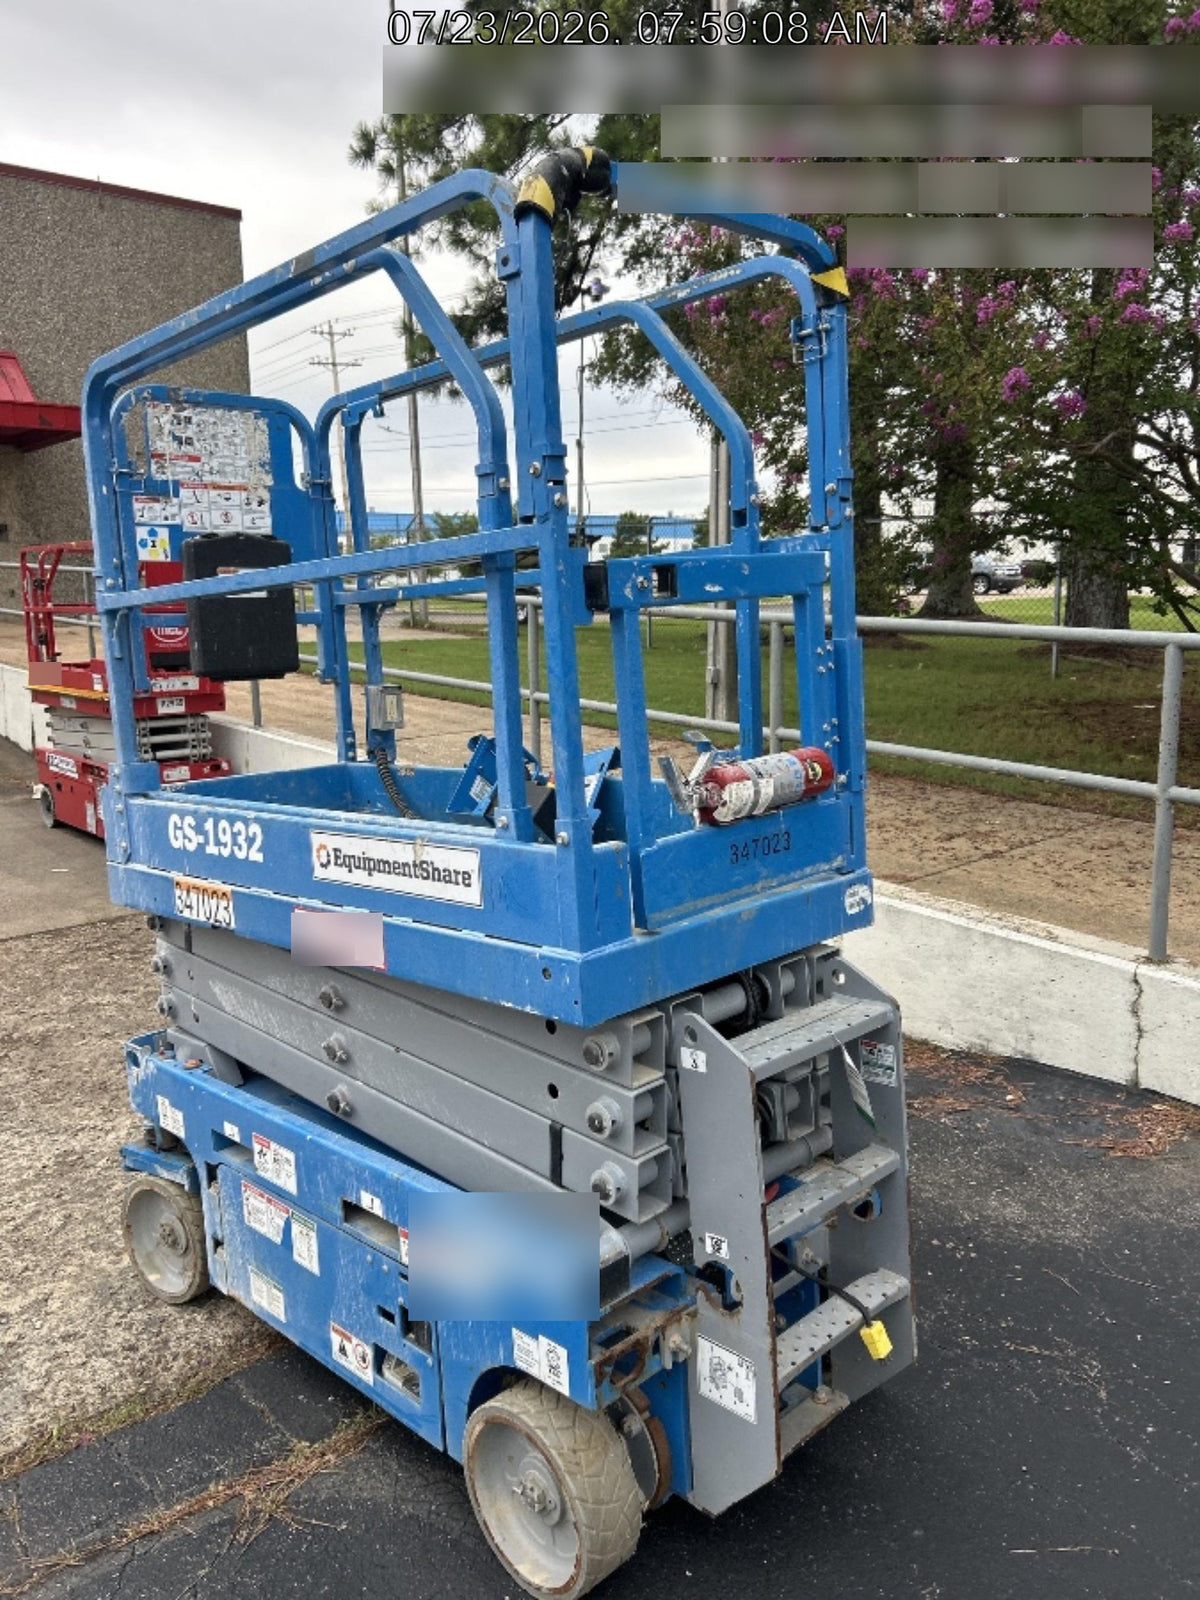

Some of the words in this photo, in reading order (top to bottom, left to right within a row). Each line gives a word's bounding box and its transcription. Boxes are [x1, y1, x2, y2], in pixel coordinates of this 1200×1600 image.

[168, 813, 264, 862] GS-1932
[729, 831, 791, 864] 347023
[333, 848, 472, 887] EquipmentShare
[175, 881, 232, 927] 347023
